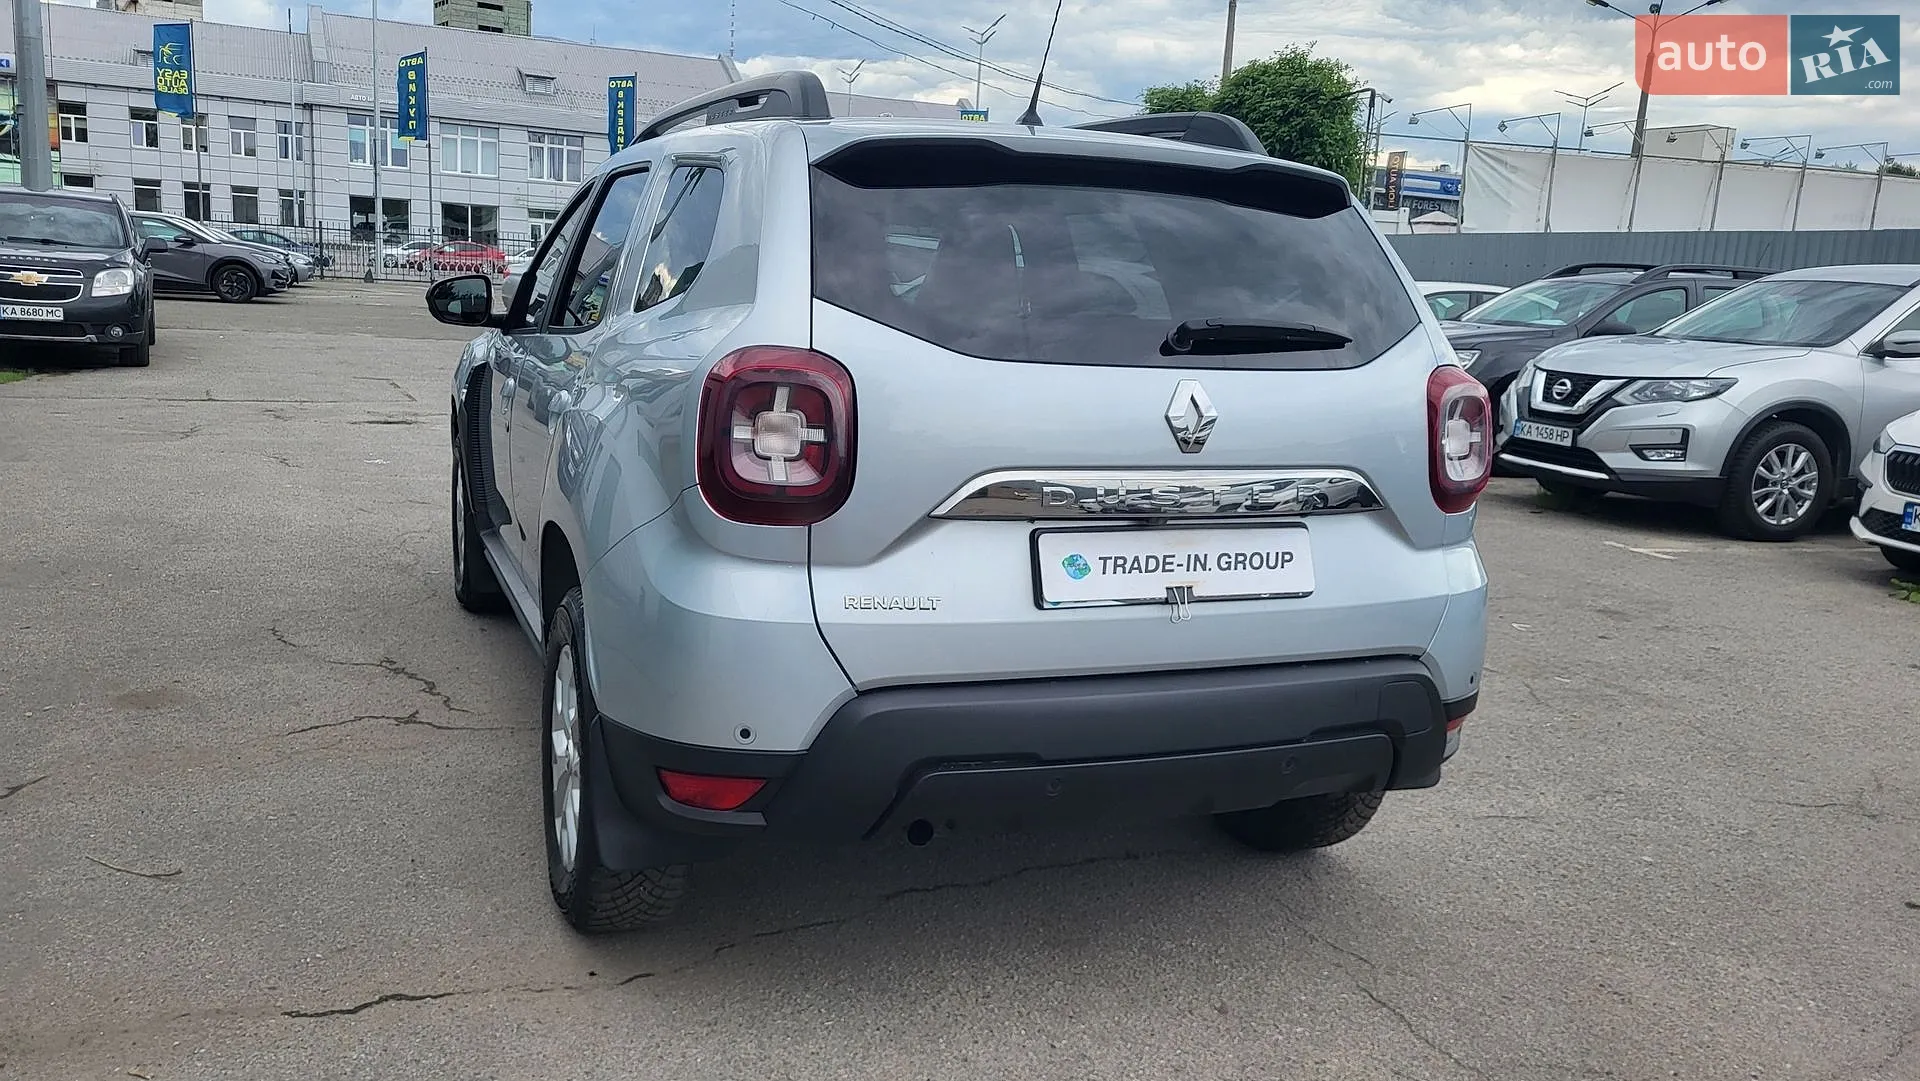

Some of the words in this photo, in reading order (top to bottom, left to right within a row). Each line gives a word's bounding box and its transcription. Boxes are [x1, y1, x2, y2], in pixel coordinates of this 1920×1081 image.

[2, 307, 17, 315] KA
[20, 308, 44, 317] 8680
[46, 309, 61, 318] MC
[1520, 423, 1532, 437] KA
[1535, 425, 1555, 441] 1458
[1555, 430, 1570, 442] HP
[1041, 485, 1322, 507] DUSTER
[1216, 551, 1294, 572] GROUP
[843, 594, 943, 611] RENAULT
